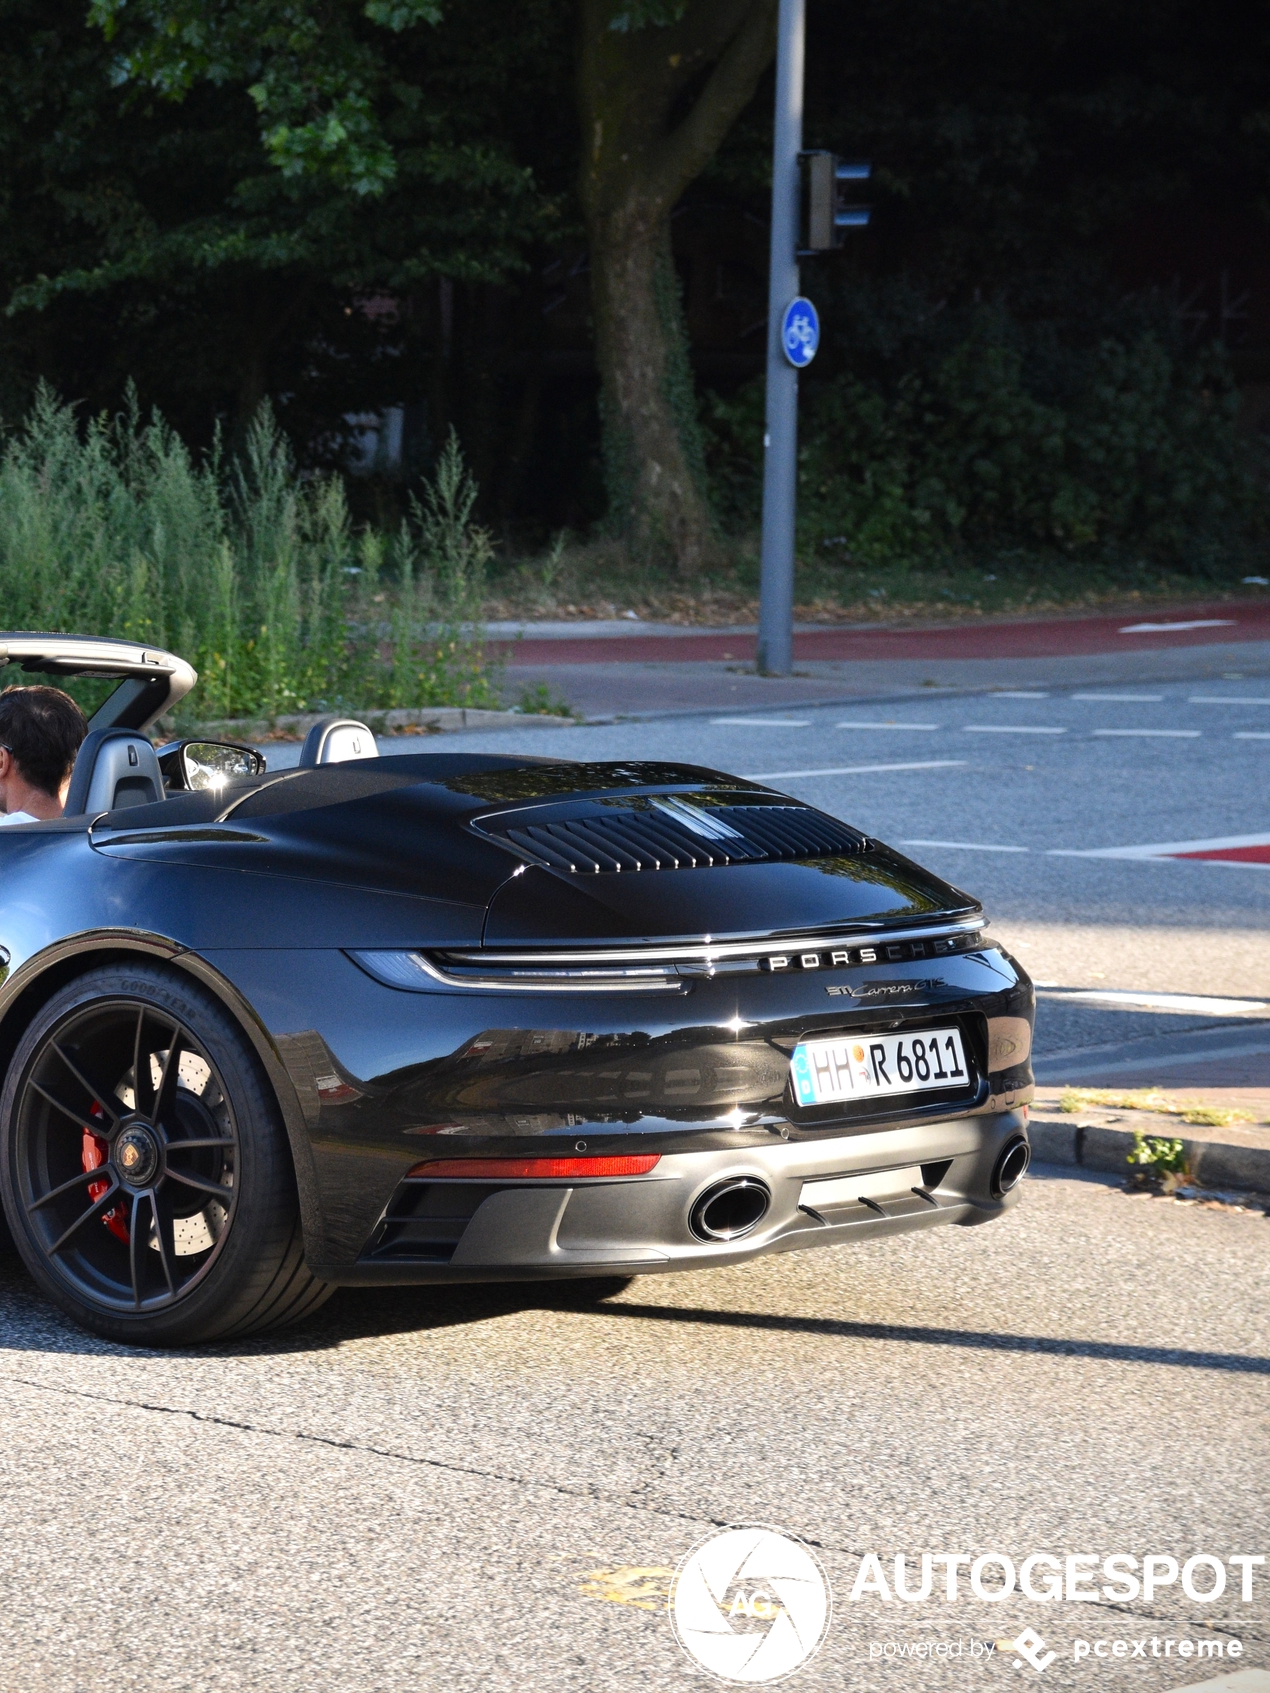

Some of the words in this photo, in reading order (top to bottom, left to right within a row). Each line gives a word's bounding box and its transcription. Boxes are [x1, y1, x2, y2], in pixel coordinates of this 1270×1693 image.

[769, 940, 948, 971] PORSCHE
[826, 985, 852, 997] 911
[851, 984, 912, 998] Carrera
[915, 977, 948, 990] GTS
[813, 1048, 854, 1093] HH
[869, 1043, 892, 1086] R
[897, 1036, 964, 1083] 6811
